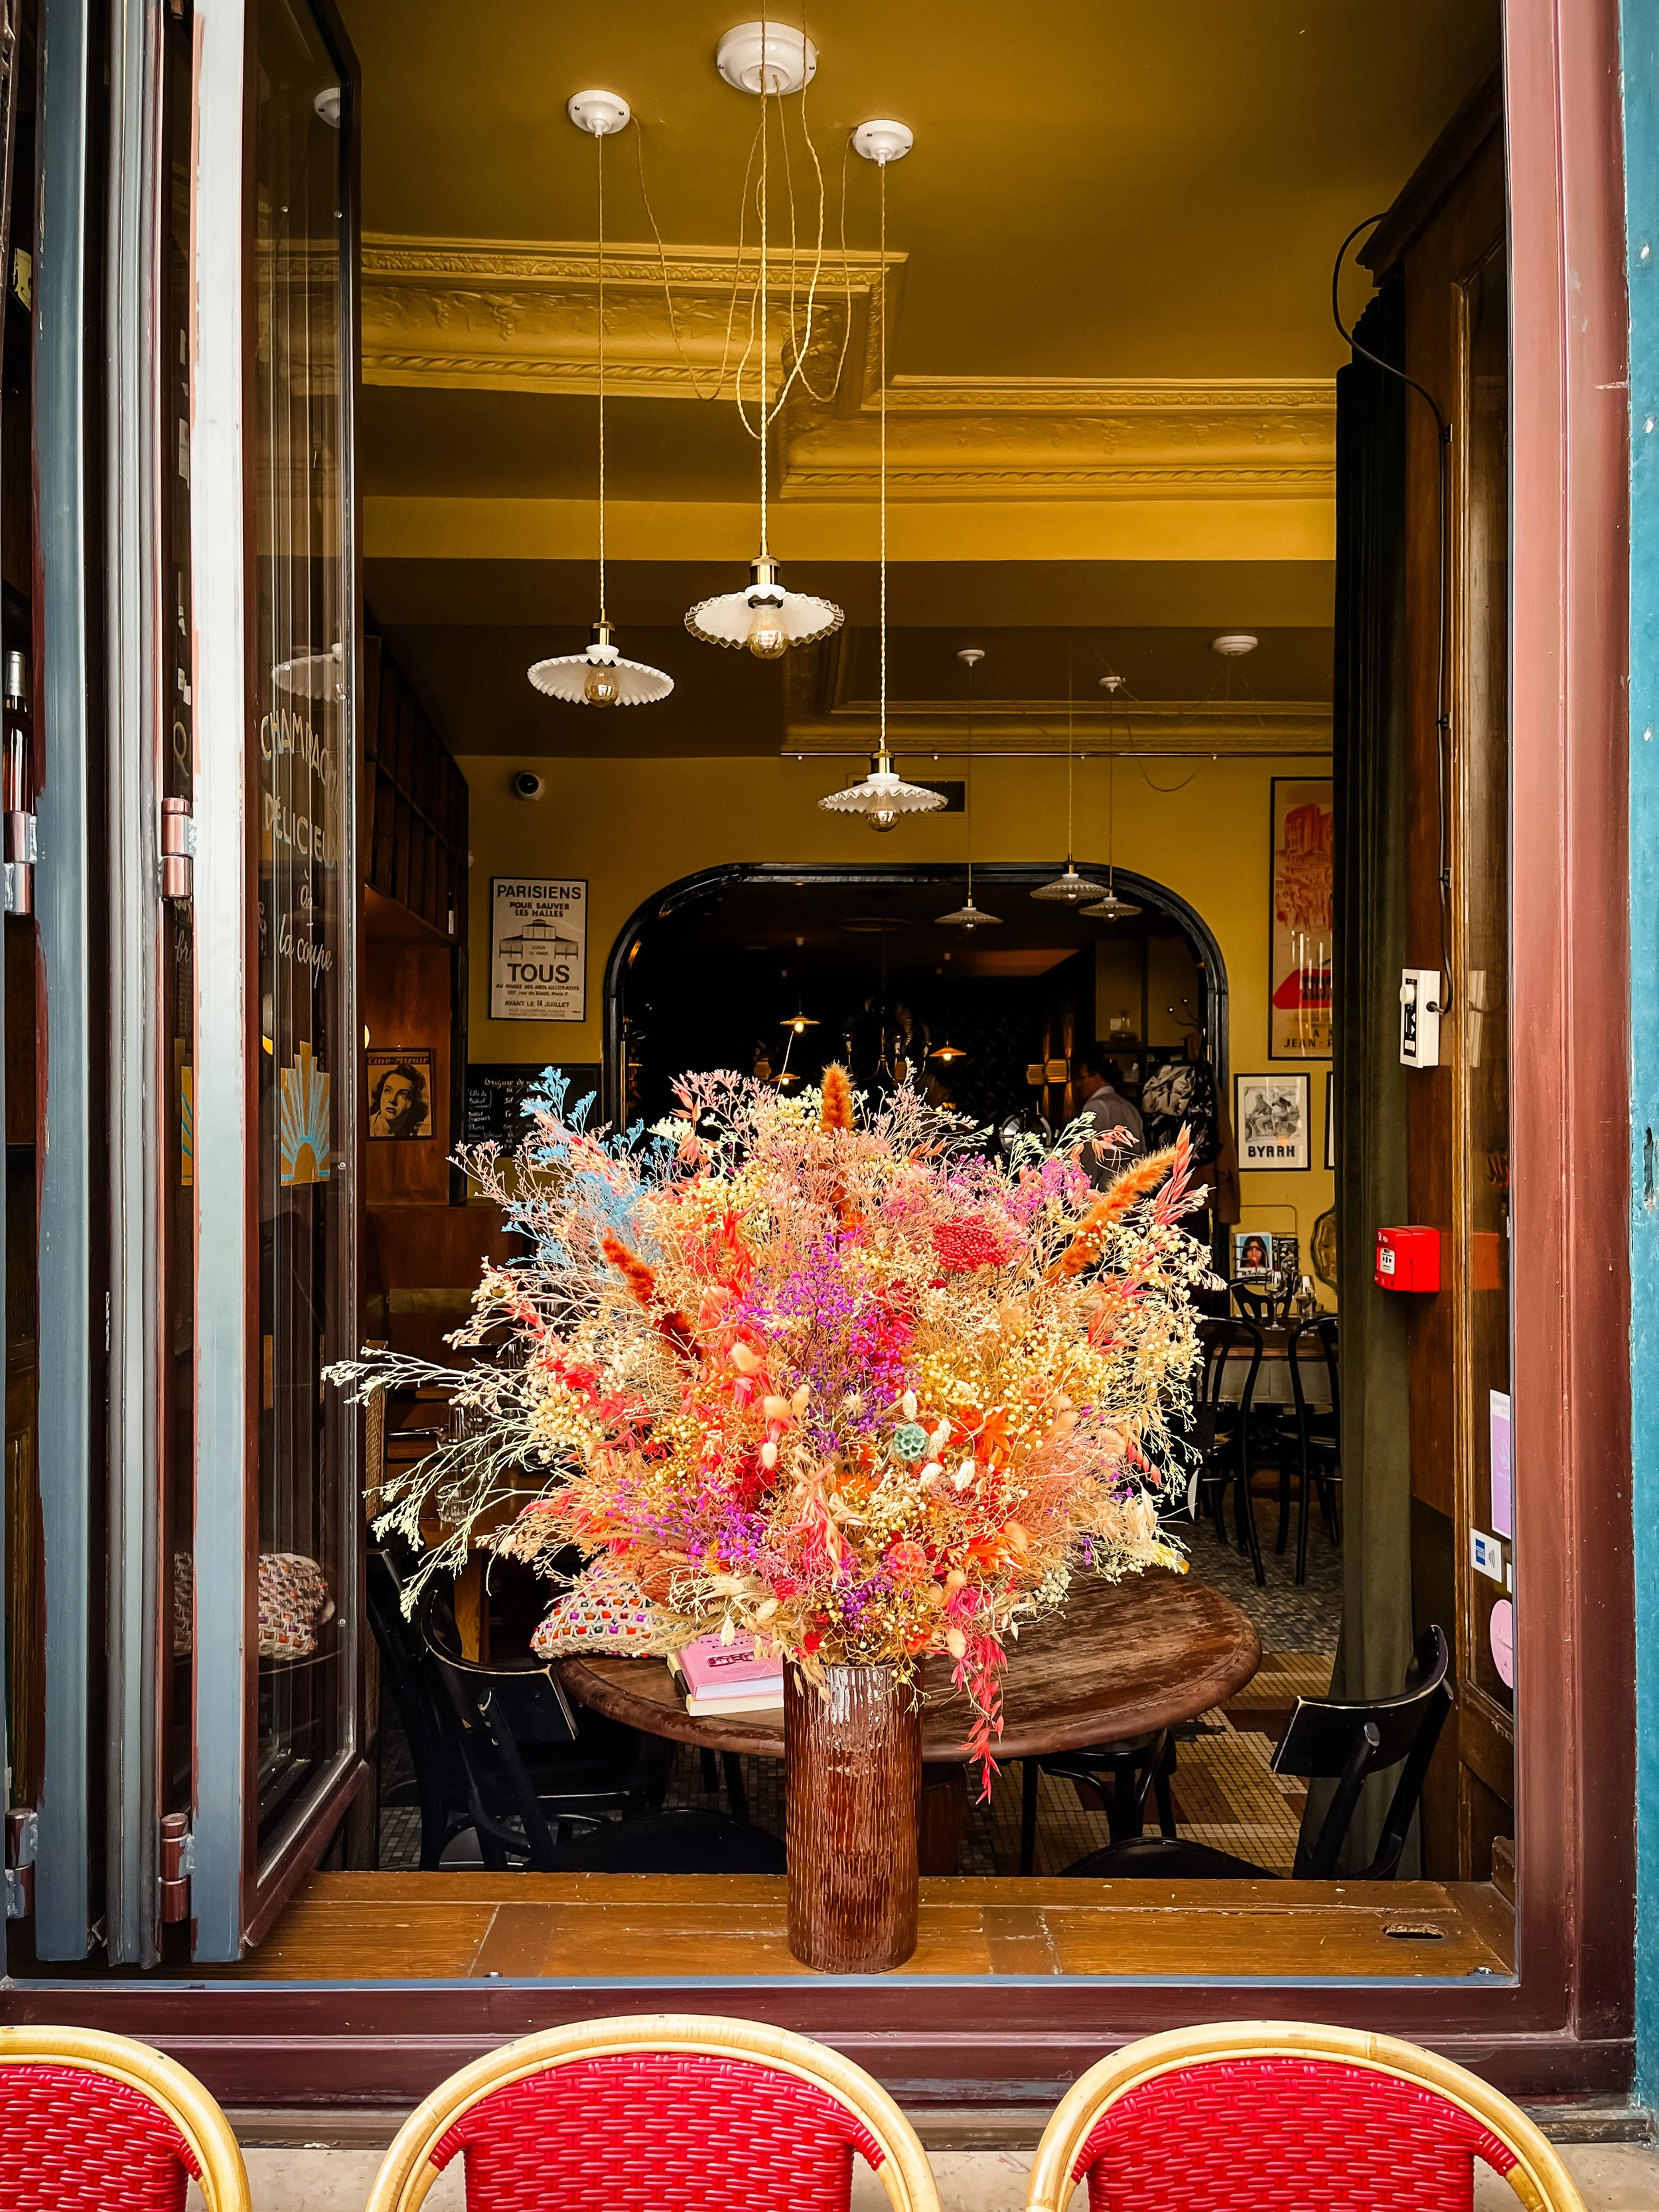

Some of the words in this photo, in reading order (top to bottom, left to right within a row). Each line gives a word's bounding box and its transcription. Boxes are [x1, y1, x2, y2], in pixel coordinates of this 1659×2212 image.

[497, 885, 582, 900] PARISIENS
[279, 913, 295, 958] la
[297, 938, 332, 989] coupe
[507, 963, 570, 984] TOUS
[1248, 1145, 1295, 1157] BYRRH
